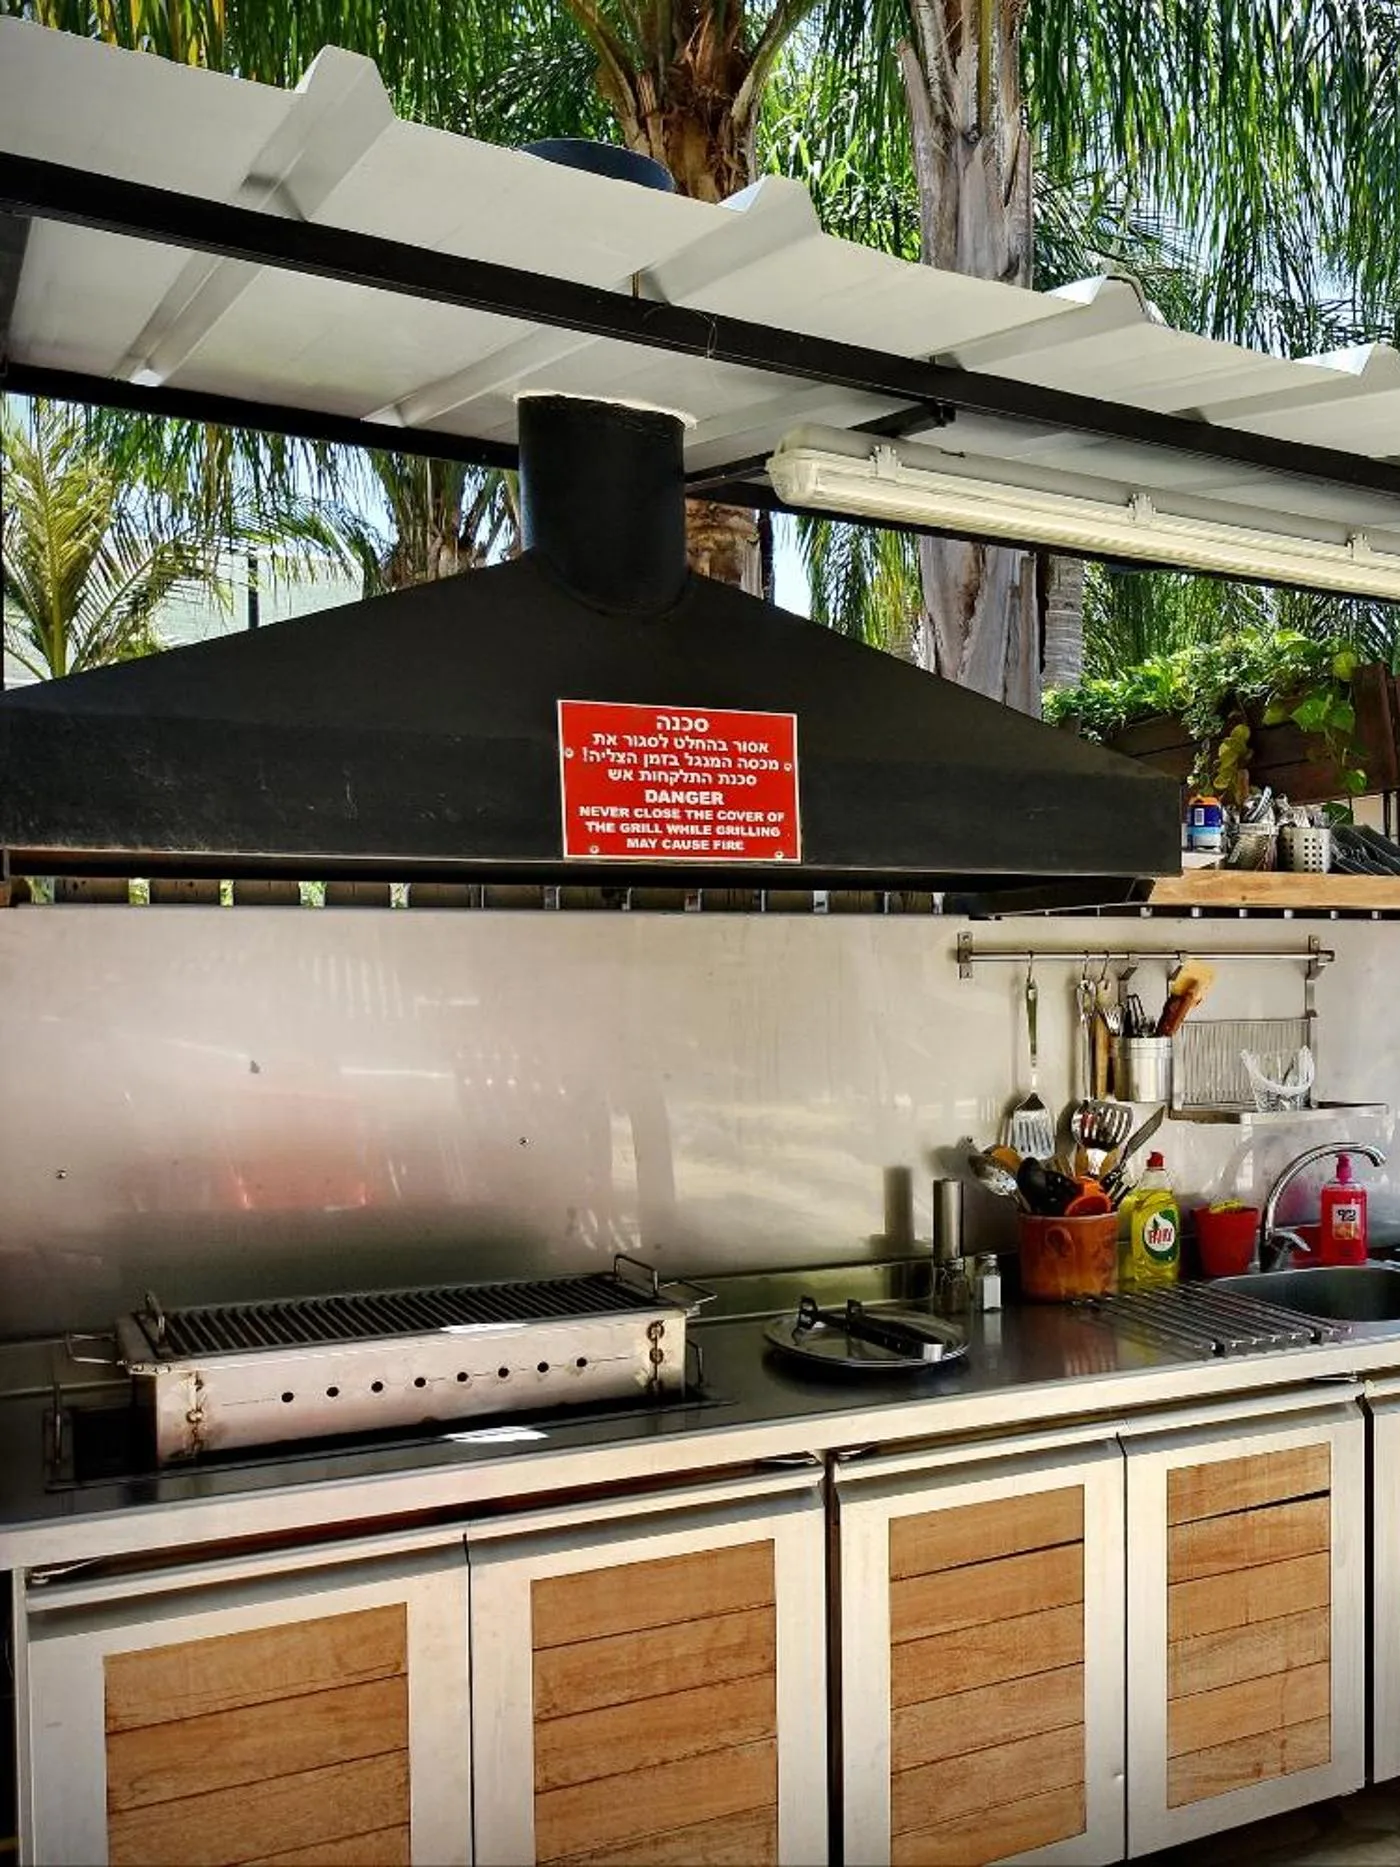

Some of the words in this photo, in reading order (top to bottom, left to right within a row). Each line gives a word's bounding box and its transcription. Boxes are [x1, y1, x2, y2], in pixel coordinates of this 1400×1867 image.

[657, 715, 709, 732] סכנה
[592, 733, 617, 746] את
[622, 734, 668, 749] לסגור
[674, 736, 728, 752] בהחלט
[733, 741, 769, 753] אסור
[644, 754, 679, 766] בזמן
[685, 753, 732, 768] המנגל
[737, 758, 779, 771] מכסה
[608, 769, 633, 781] אש
[639, 770, 712, 785] התלקחות
[718, 773, 757, 786] סכנת
[645, 789, 725, 806] DANGER
[579, 806, 629, 818] NEVER
[633, 808, 681, 820] CLOSE
[685, 809, 713, 821] THE
[717, 810, 764, 822] COVER
[767, 812, 784, 822] OF
[585, 821, 615, 833] THE
[620, 823, 662, 834] GRILL
[666, 825, 712, 836] WHILE
[716, 826, 780, 837] GRILLING
[627, 838, 657, 849] MAY
[661, 839, 710, 850] CAUSE
[713, 840, 744, 851] FIRE
